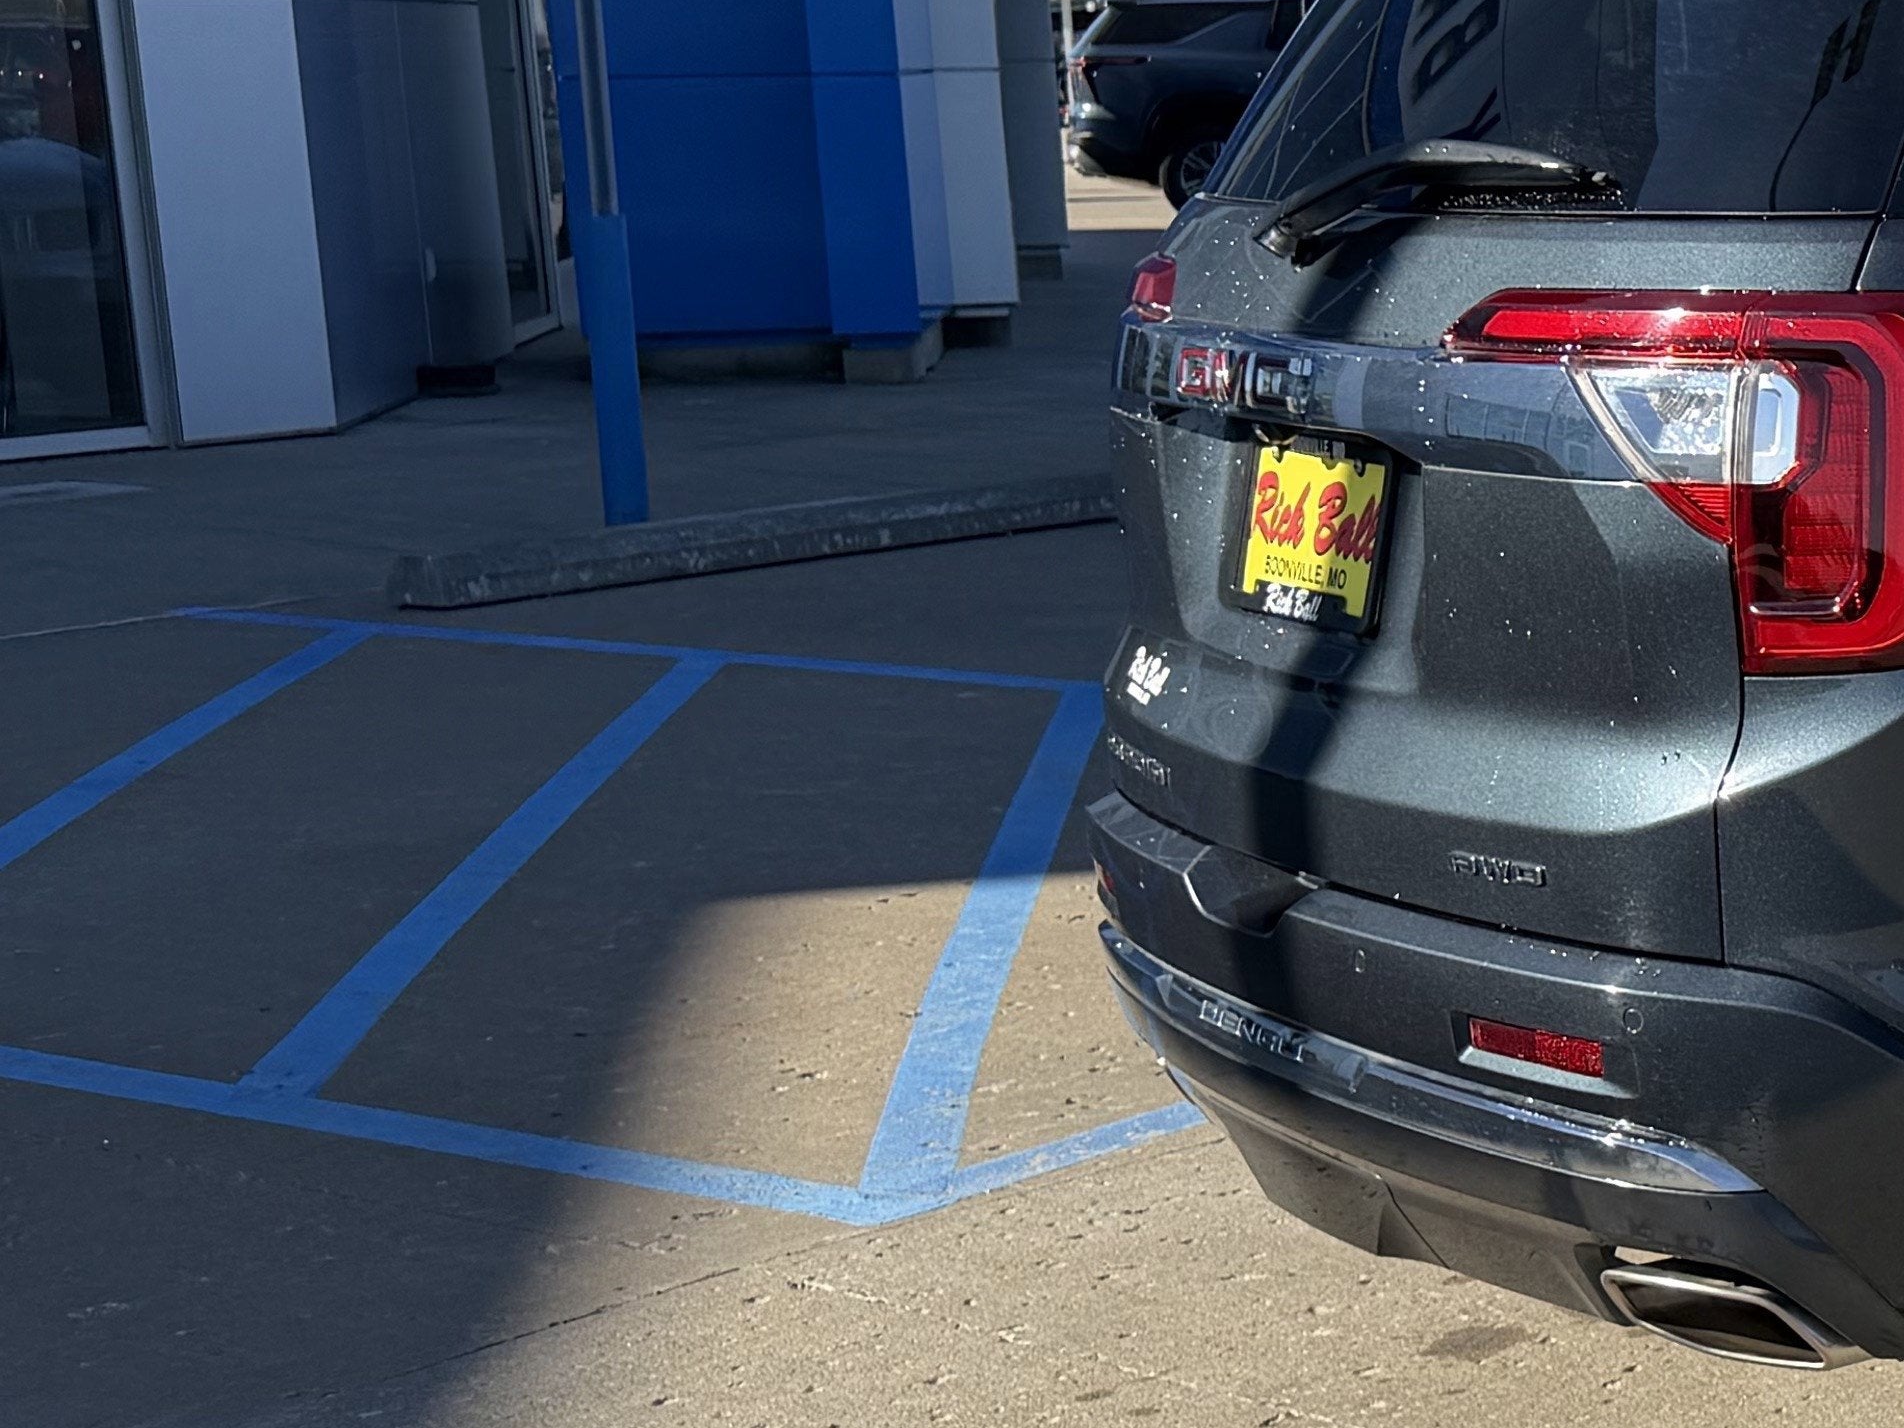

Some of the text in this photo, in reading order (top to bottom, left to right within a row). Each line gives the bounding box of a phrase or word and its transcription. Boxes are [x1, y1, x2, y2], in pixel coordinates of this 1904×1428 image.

[1254, 470, 1382, 565] Rick Ball
[1264, 554, 1348, 590] BOONVILLE, MO
[1448, 850, 1547, 887] AWD
